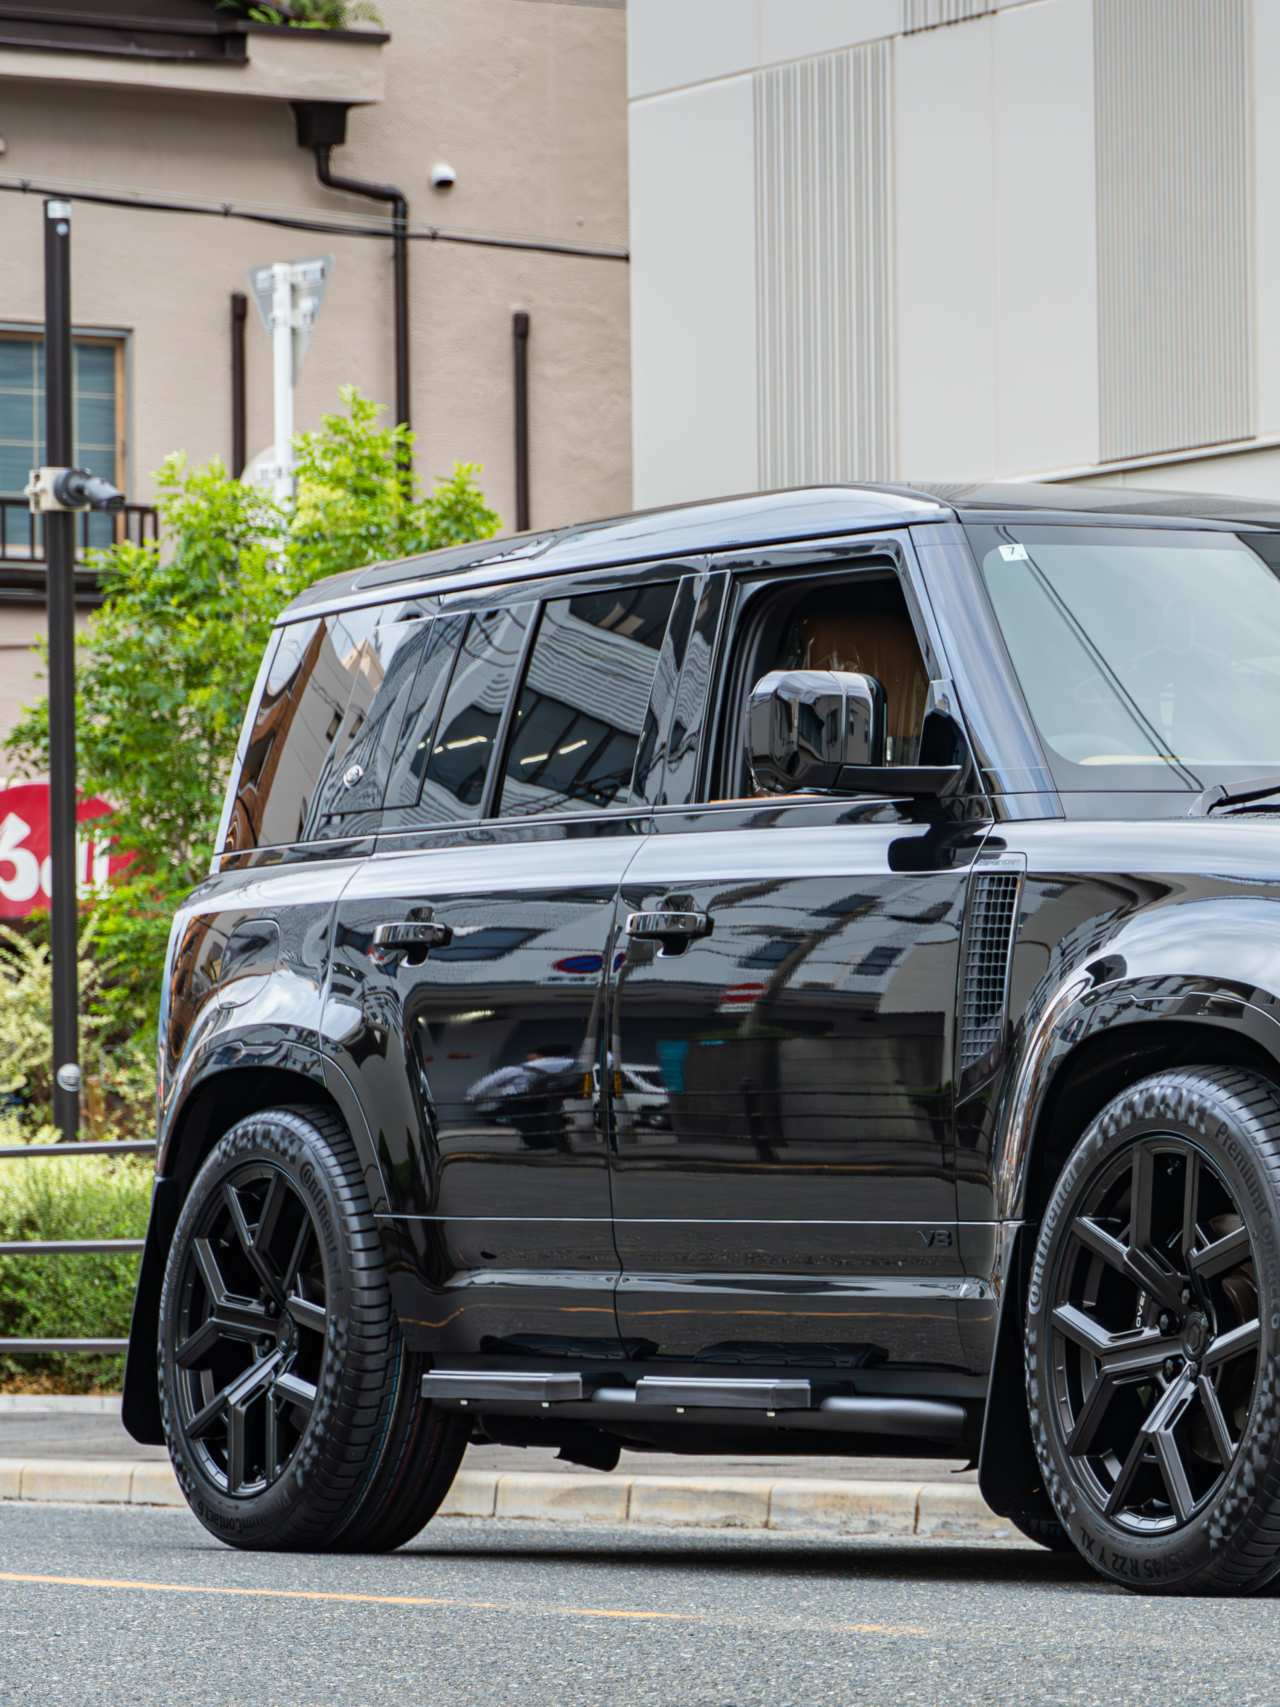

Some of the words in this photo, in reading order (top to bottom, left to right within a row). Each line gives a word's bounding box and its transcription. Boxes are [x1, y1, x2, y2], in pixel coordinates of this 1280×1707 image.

[917, 1229, 953, 1248] V8
[1028, 1165, 1079, 1315] Continental
[1079, 1526, 1096, 1557] XL
[1111, 1552, 1141, 1579] R22
